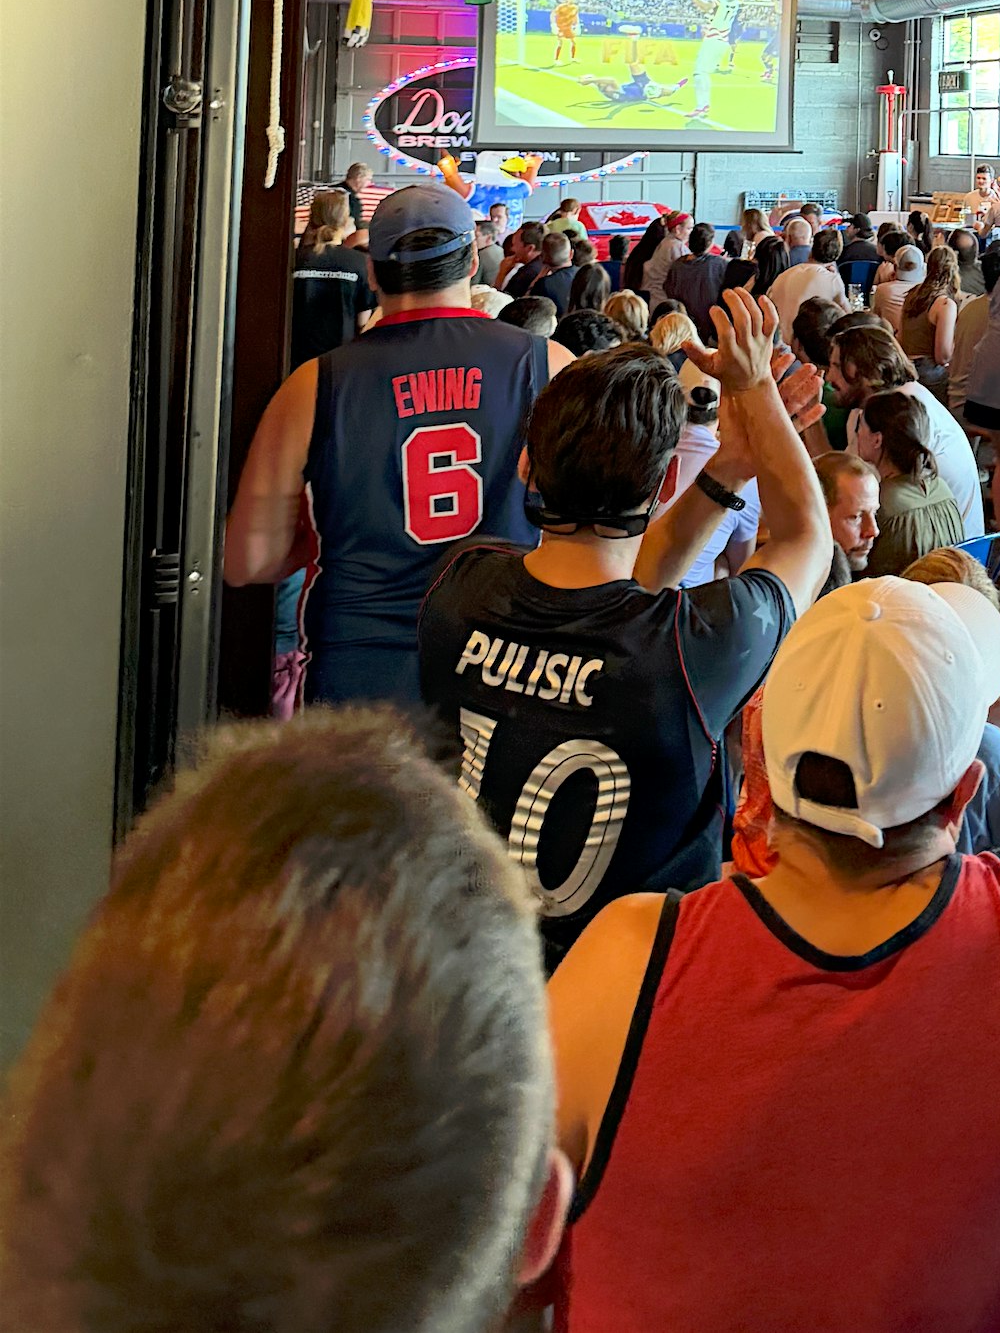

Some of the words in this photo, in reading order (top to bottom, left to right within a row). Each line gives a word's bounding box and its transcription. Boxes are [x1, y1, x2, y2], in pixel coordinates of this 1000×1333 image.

[602, 38, 678, 66] FIFA
[392, 367, 483, 418] EWING
[401, 421, 484, 545] 6
[455, 630, 604, 707] PULISIC
[457, 706, 632, 917] 10
